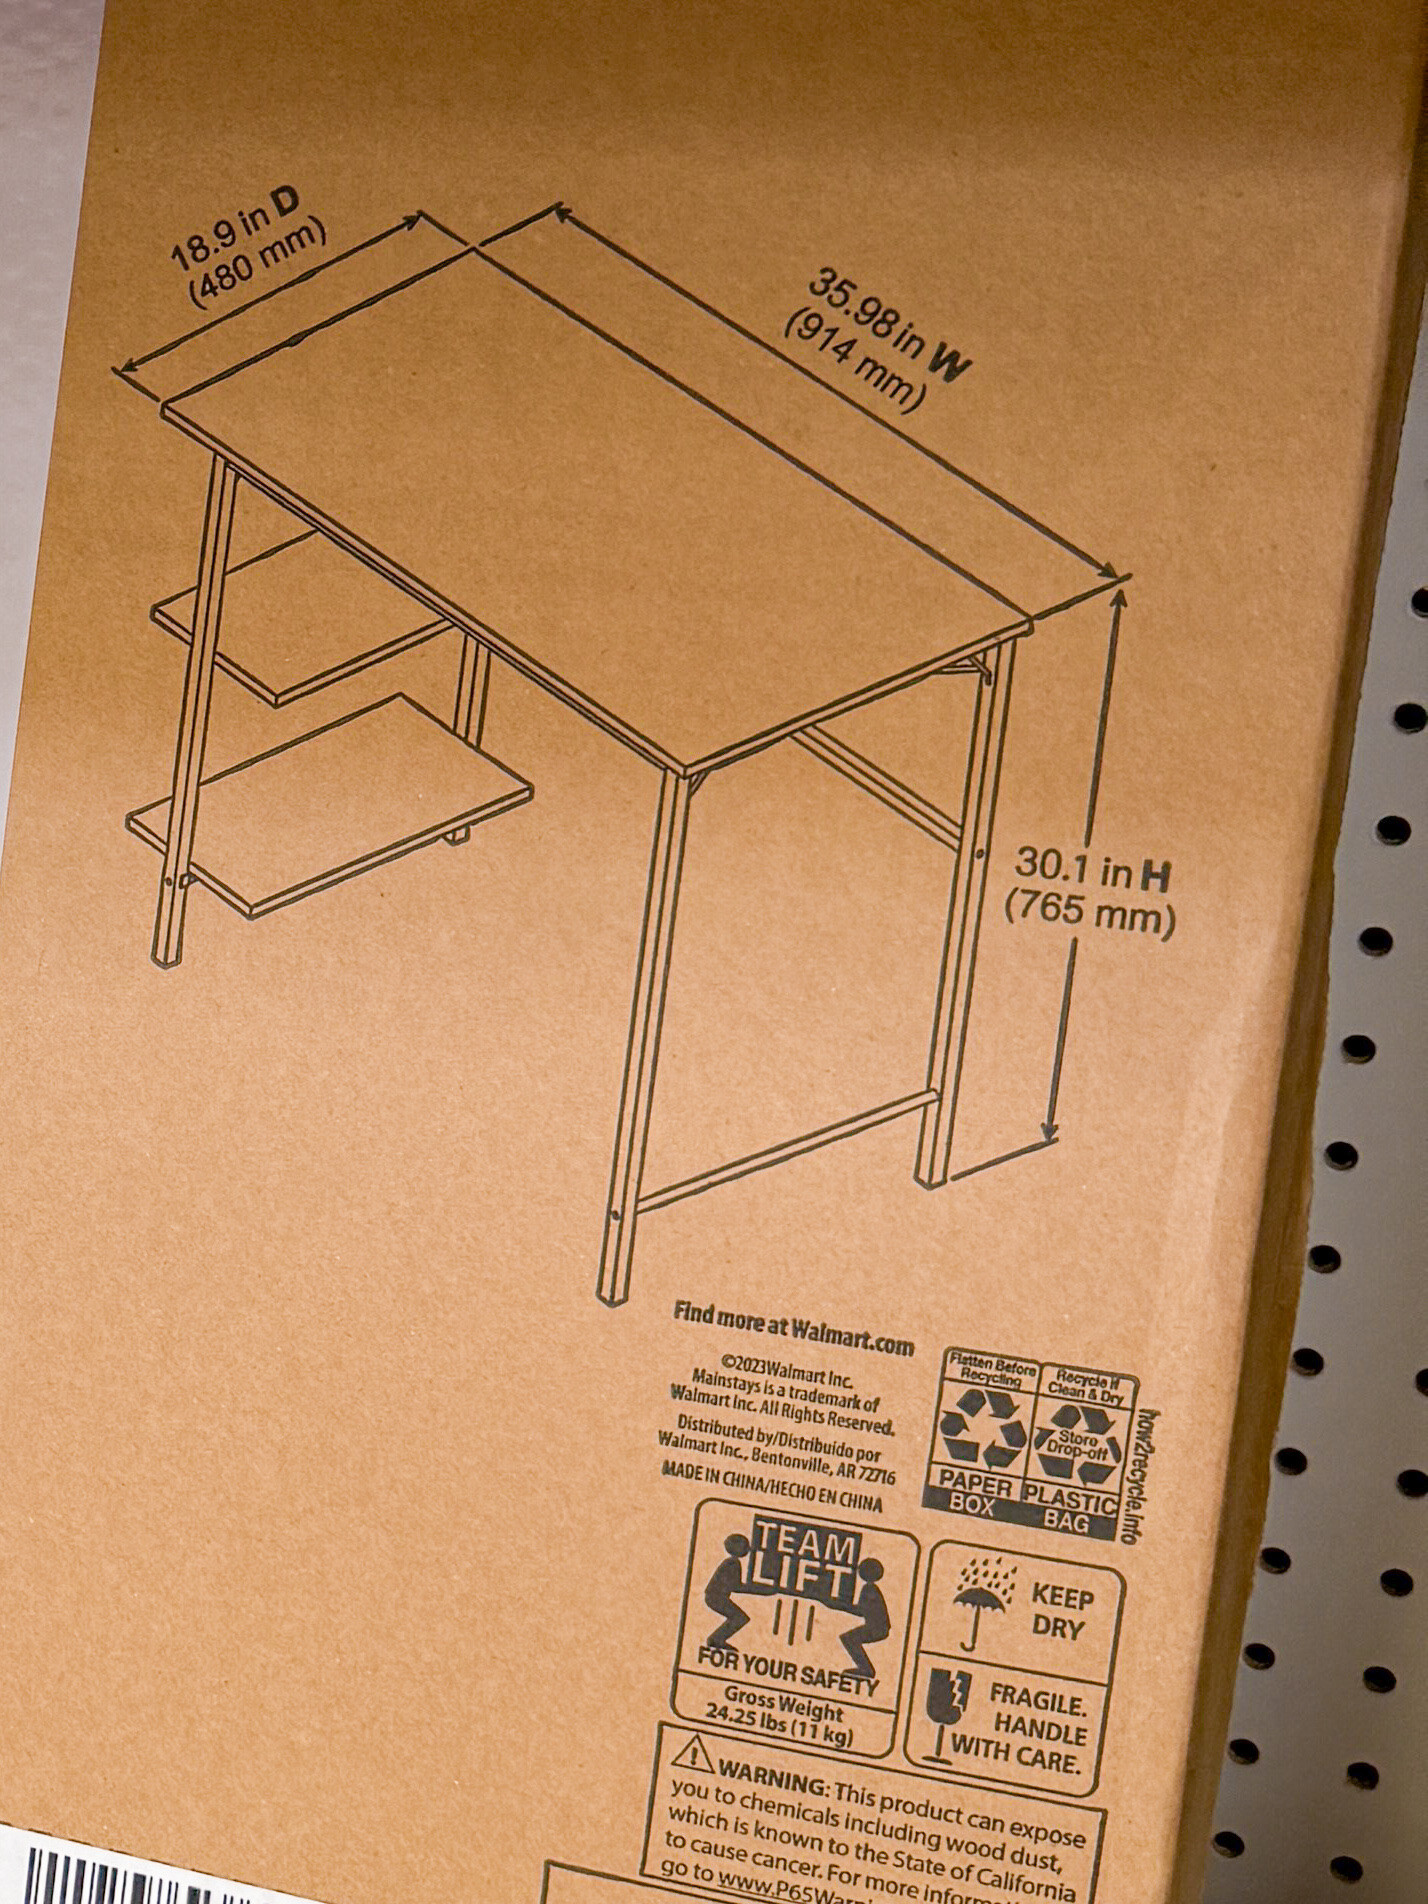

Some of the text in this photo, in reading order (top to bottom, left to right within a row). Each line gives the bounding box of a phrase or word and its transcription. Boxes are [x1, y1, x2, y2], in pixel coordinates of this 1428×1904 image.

[170, 184, 300, 272] 18.9 in D
[188, 214, 327, 311] (480 mm)
[808, 266, 974, 384] 35.98 in W
[784, 306, 928, 416] (914 mm)
[1014, 845, 1173, 894] 30.1 in H
[1004, 886, 1177, 943] (765 mm)
[673, 1299, 916, 1358] Find more at Walmart.com
[939, 1468, 1013, 1498] PAPER
[1022, 1482, 1119, 1516] PLASTIC
[756, 1520, 856, 1565] TEAM
[752, 1550, 853, 1598] LIFT
[1032, 1581, 1095, 1611] KEEP
[1032, 1613, 1086, 1641] DRY
[724, 1685, 845, 1724] Gross Weight
[990, 1681, 1088, 1718] FRAGILE.
[705, 1701, 854, 1749] 24.25 lbs (11 kg)
[994, 1711, 1088, 1747] HANDLE
[951, 1732, 1082, 1776] WITH CARE.
[718, 1758, 1087, 1850] WARNING: This product can expose
